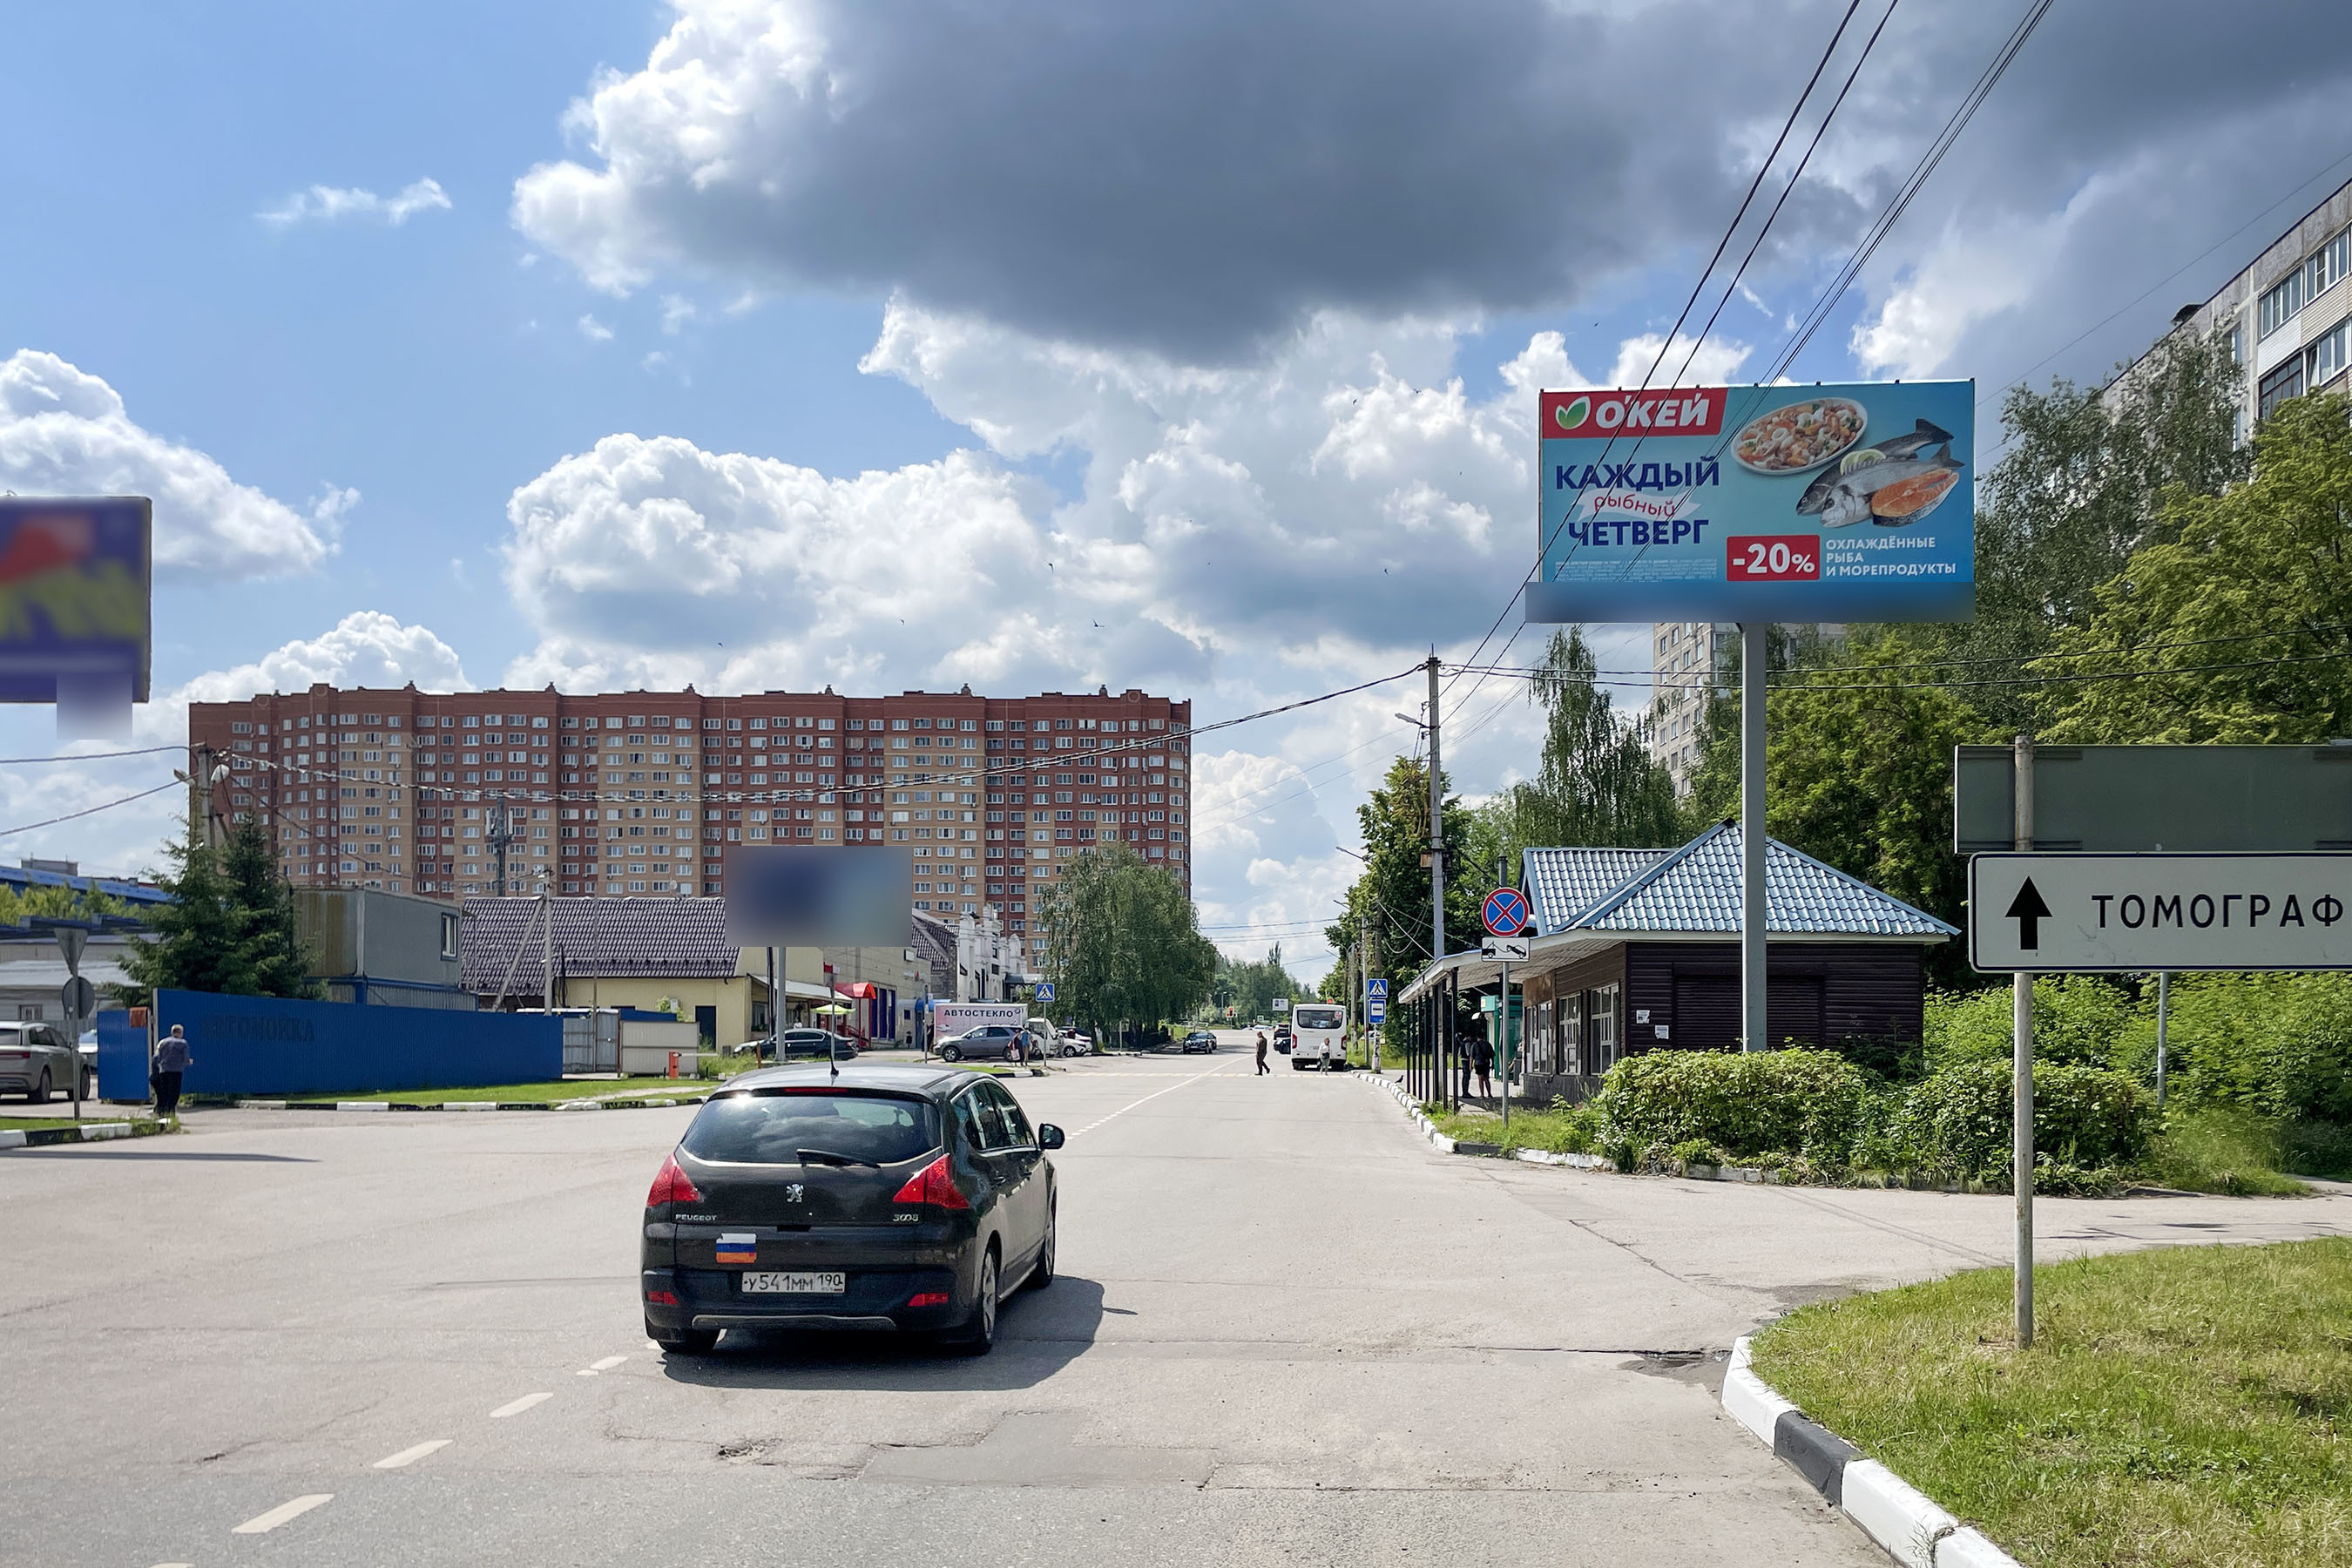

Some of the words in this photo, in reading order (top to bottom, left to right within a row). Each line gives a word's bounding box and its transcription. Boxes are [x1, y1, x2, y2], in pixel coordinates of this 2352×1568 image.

[1556, 456, 1720, 491] КАЖДЫЙ
[1594, 493, 1676, 517] рыбный
[1569, 519, 1709, 546] ЧЕТВЕРГ
[1826, 536, 1936, 551] ОХЛАЖДЁННЫЕ
[1733, 543, 1815, 573] -20%
[1826, 552, 1864, 564] РЫБА
[1826, 566, 1836, 577] И
[1839, 563, 1956, 577] МОРЕПРОДУКТЫ
[2091, 894, 2343, 929] ТОМОГРАФ
[944, 1009, 1013, 1017] АВТОСТЕКЛО
[817, 1274, 841, 1287] 190
